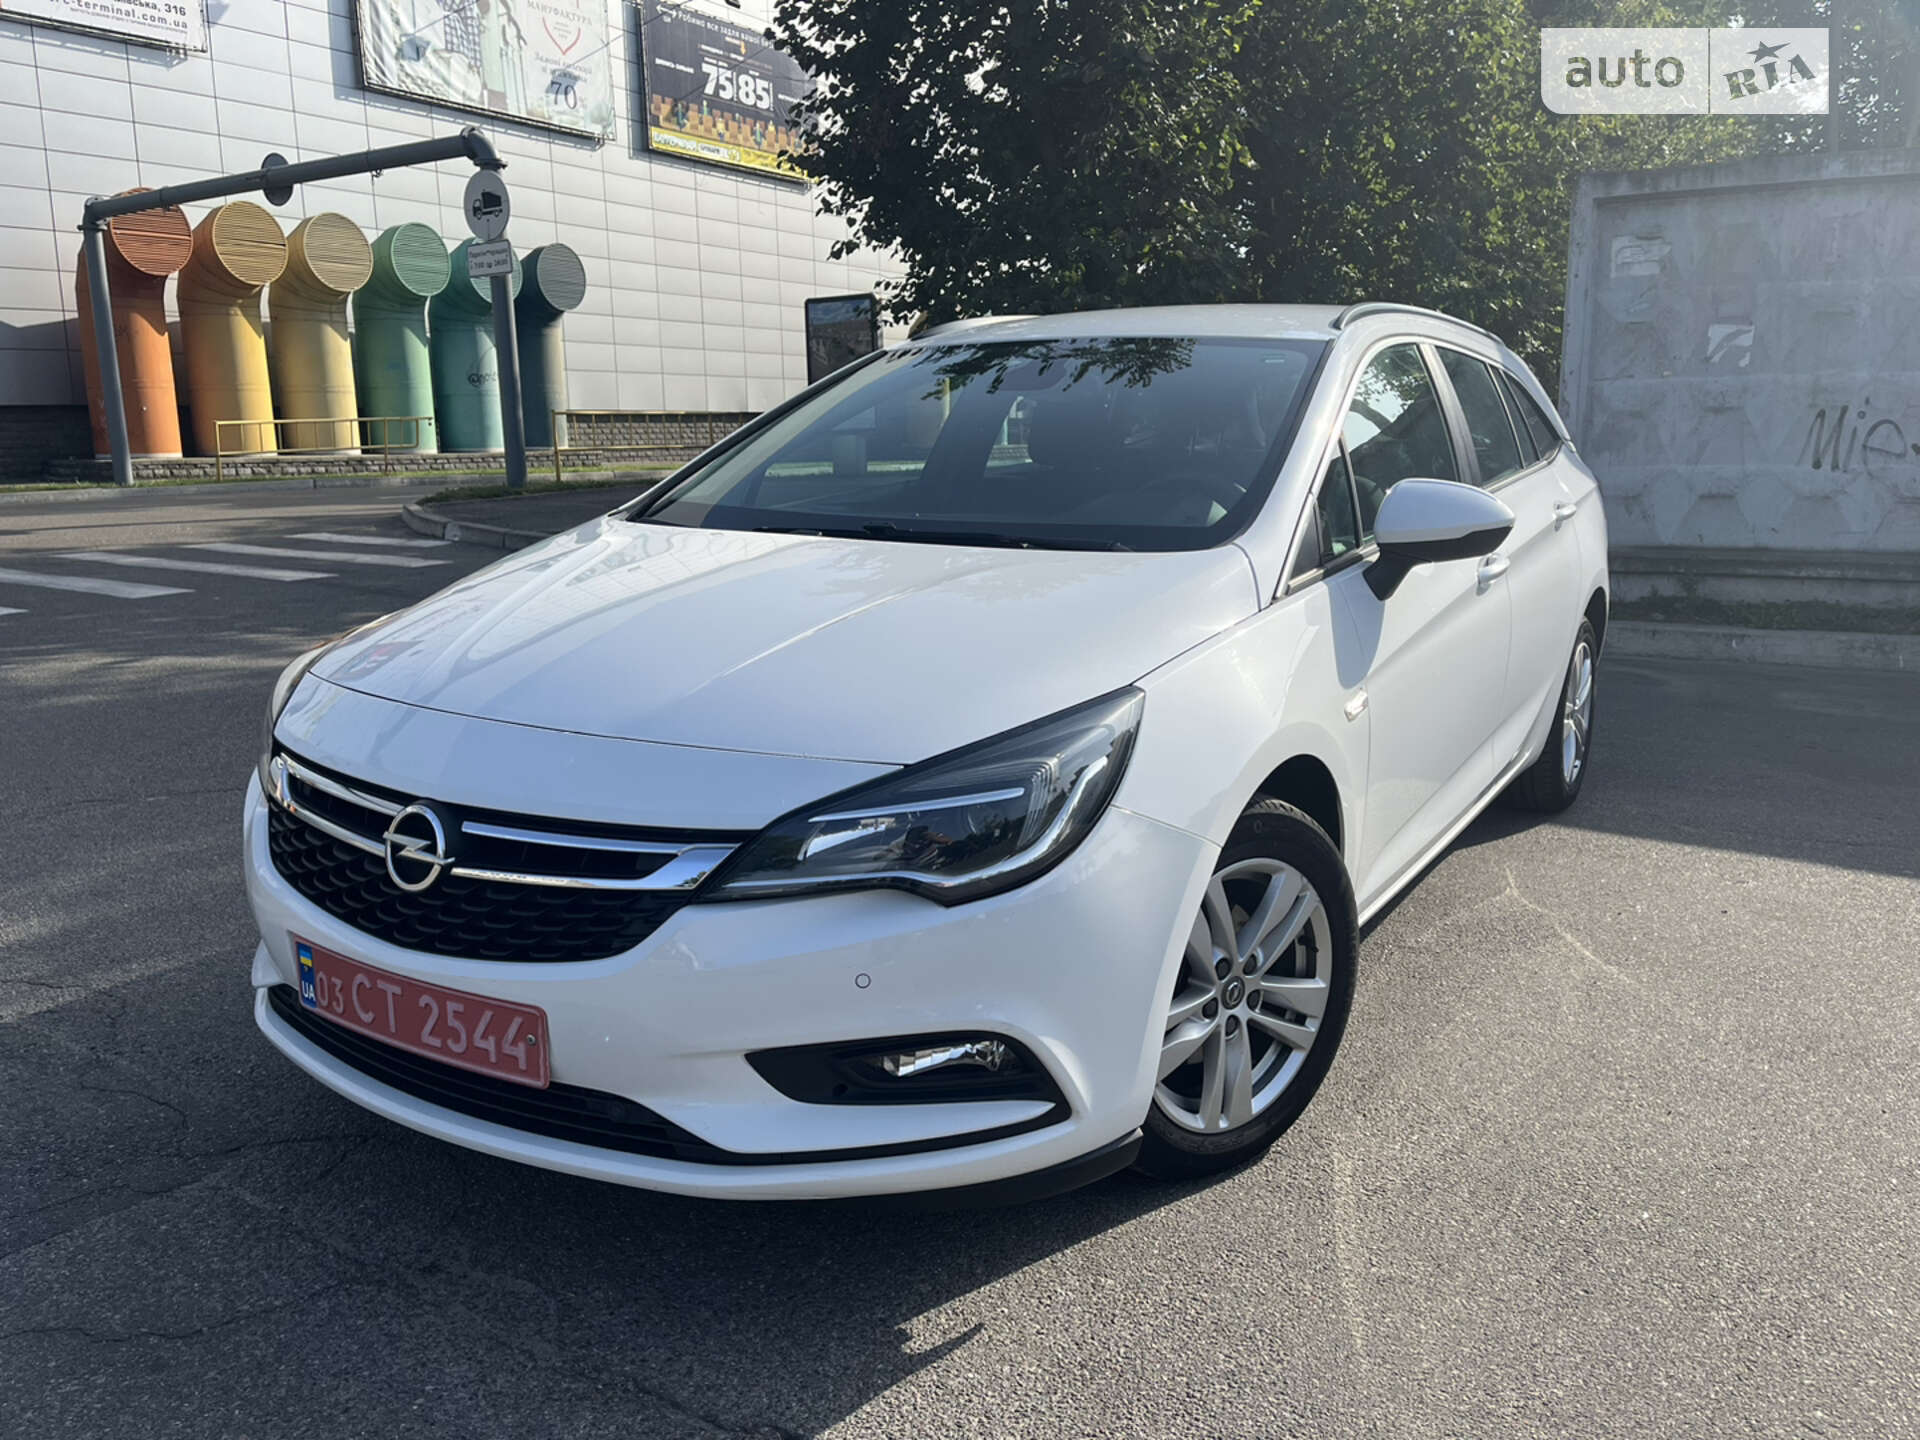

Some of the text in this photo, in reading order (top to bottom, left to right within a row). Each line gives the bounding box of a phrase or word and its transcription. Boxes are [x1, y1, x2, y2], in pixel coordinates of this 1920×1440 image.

[50, 0, 188, 29] c-terminal.com.ua
[164, 4, 186, 16] 316
[550, 79, 577, 110] 70
[702, 62, 733, 101] 75
[738, 74, 770, 111] 85
[301, 980, 316, 1002] UA
[316, 971, 528, 1071] 03 CT 2544
